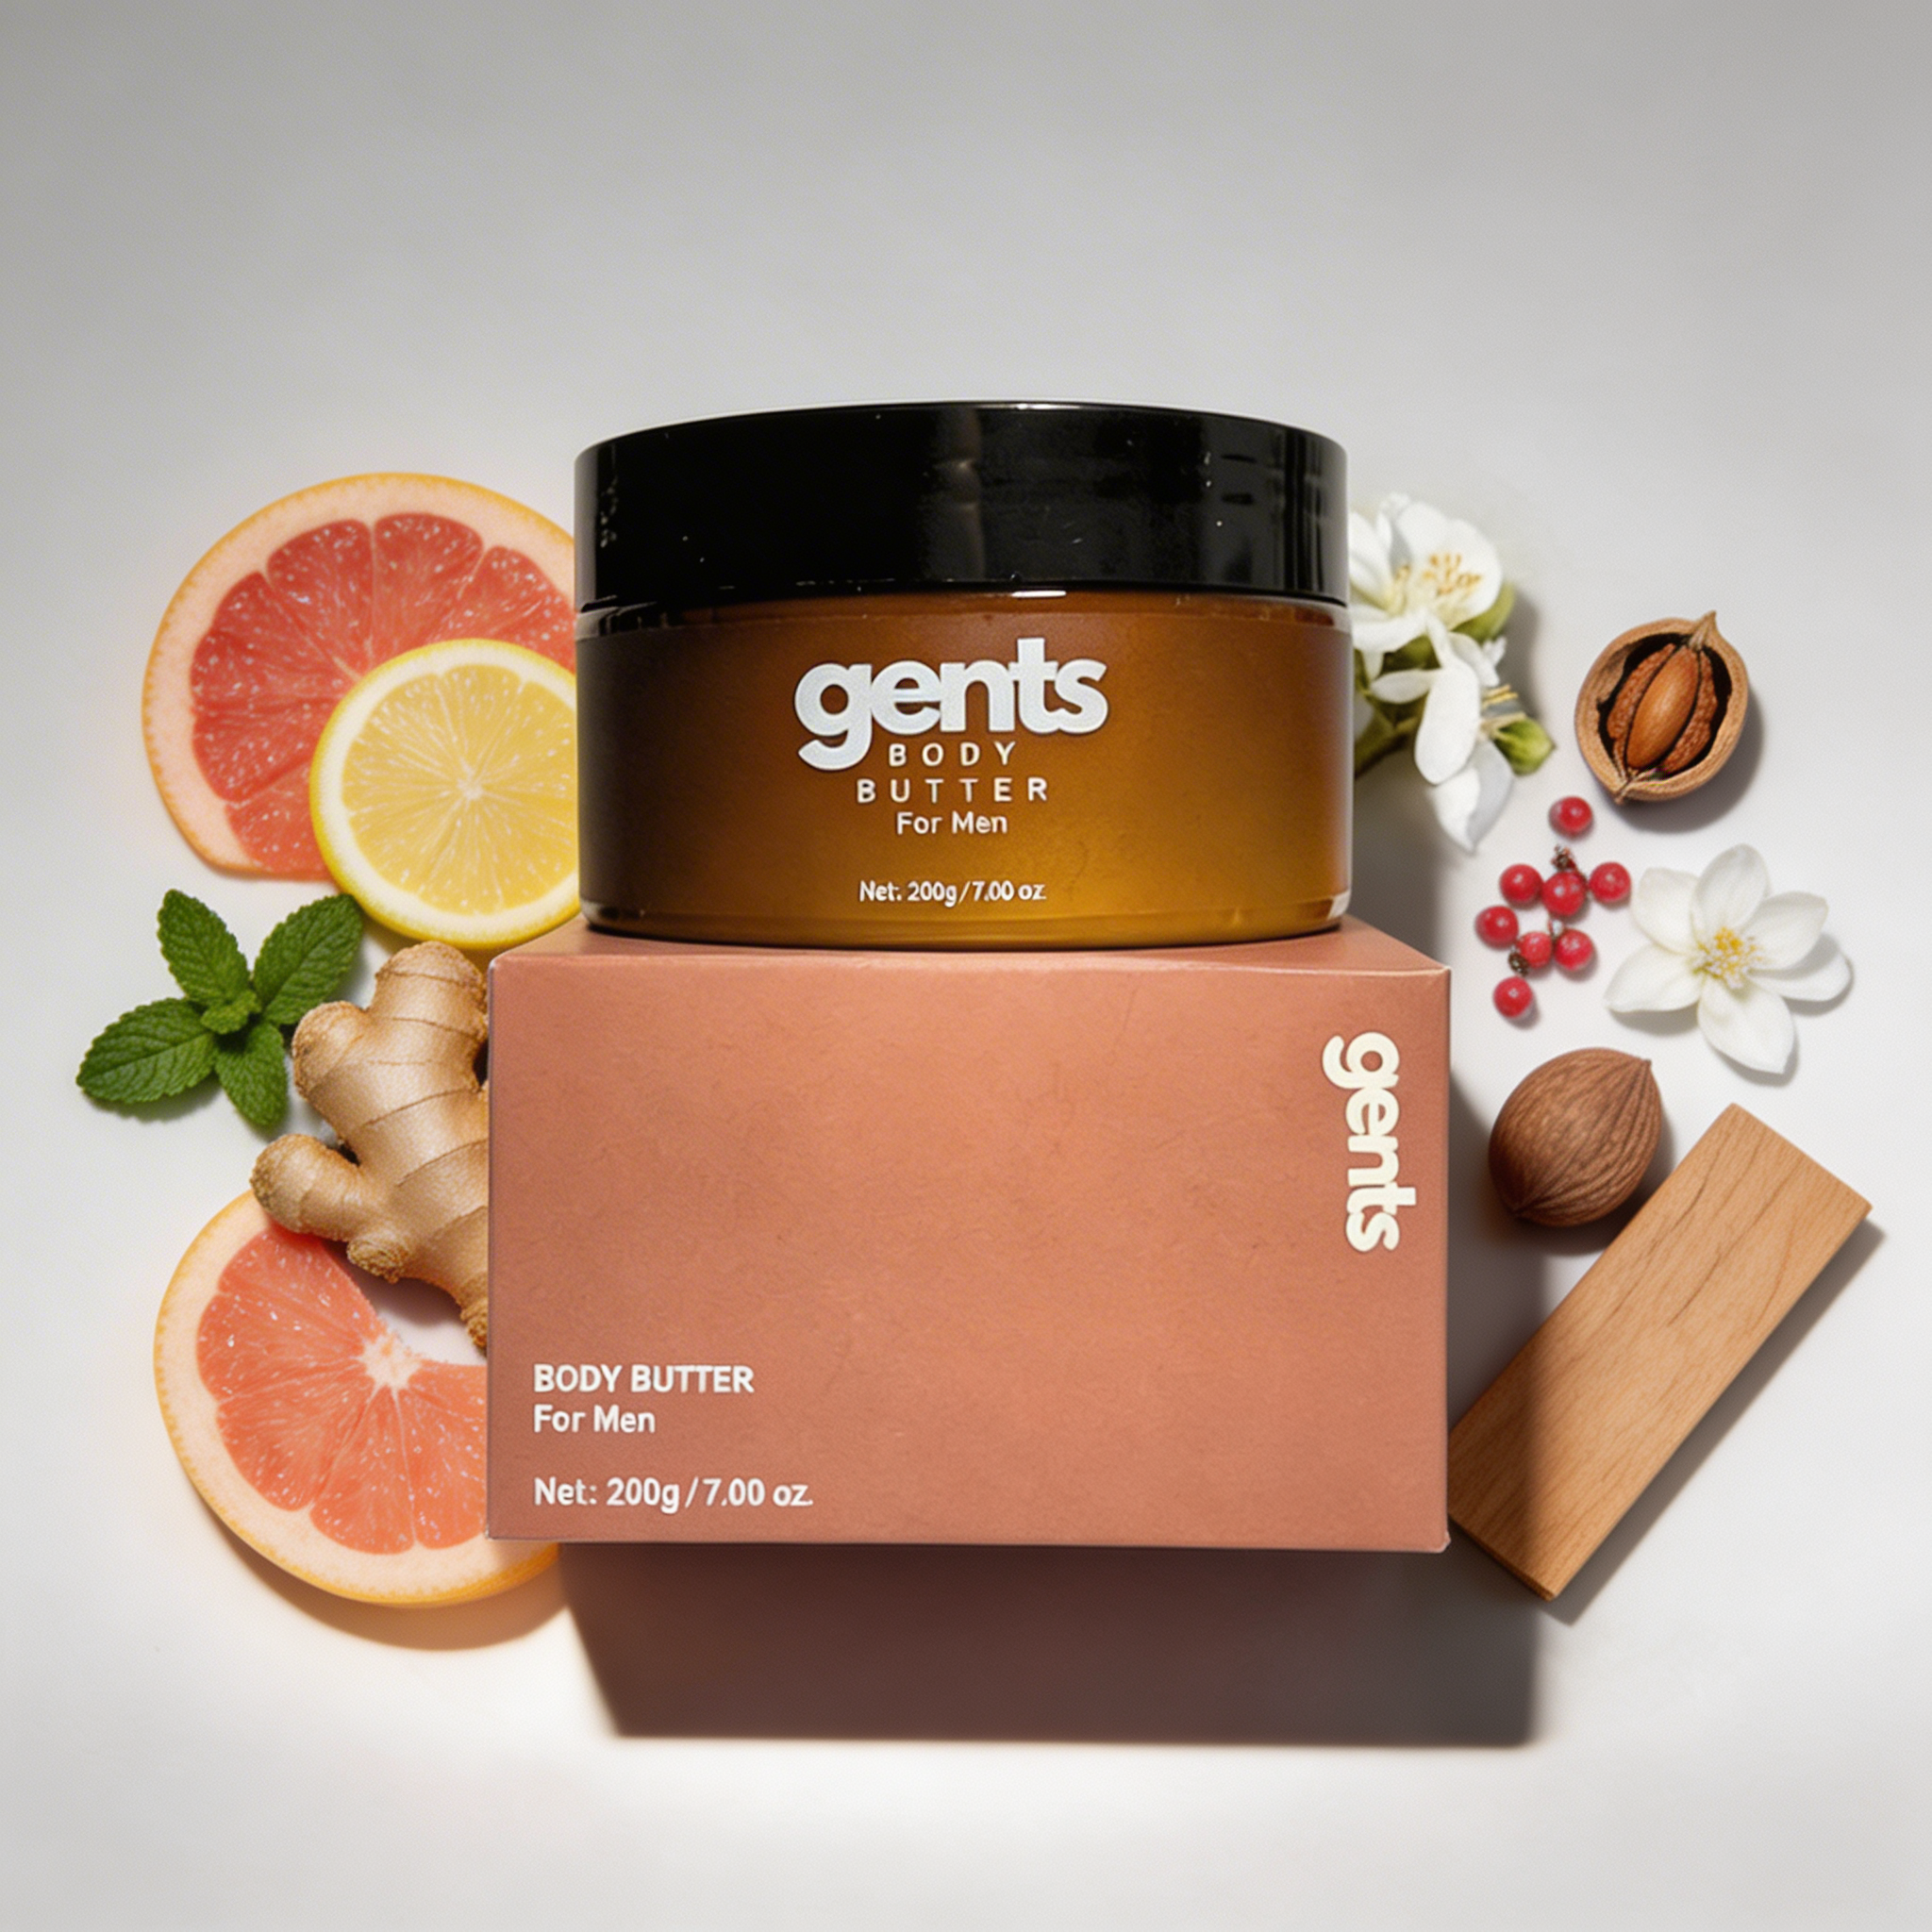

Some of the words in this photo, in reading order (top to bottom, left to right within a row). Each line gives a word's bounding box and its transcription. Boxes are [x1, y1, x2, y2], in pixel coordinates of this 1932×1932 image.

[794, 638, 1108, 771] gents
[889, 741, 1016, 767] BODY
[857, 777, 1048, 804] BUTTER
[897, 811, 942, 835] For
[952, 811, 1008, 834] Men
[1323, 1032, 1416, 1252] gents
[534, 1364, 622, 1393] BODY
[631, 1364, 754, 1393] BUTTER
[534, 1404, 585, 1433] For
[593, 1405, 656, 1433] Men
[534, 1476, 597, 1506] Net:
